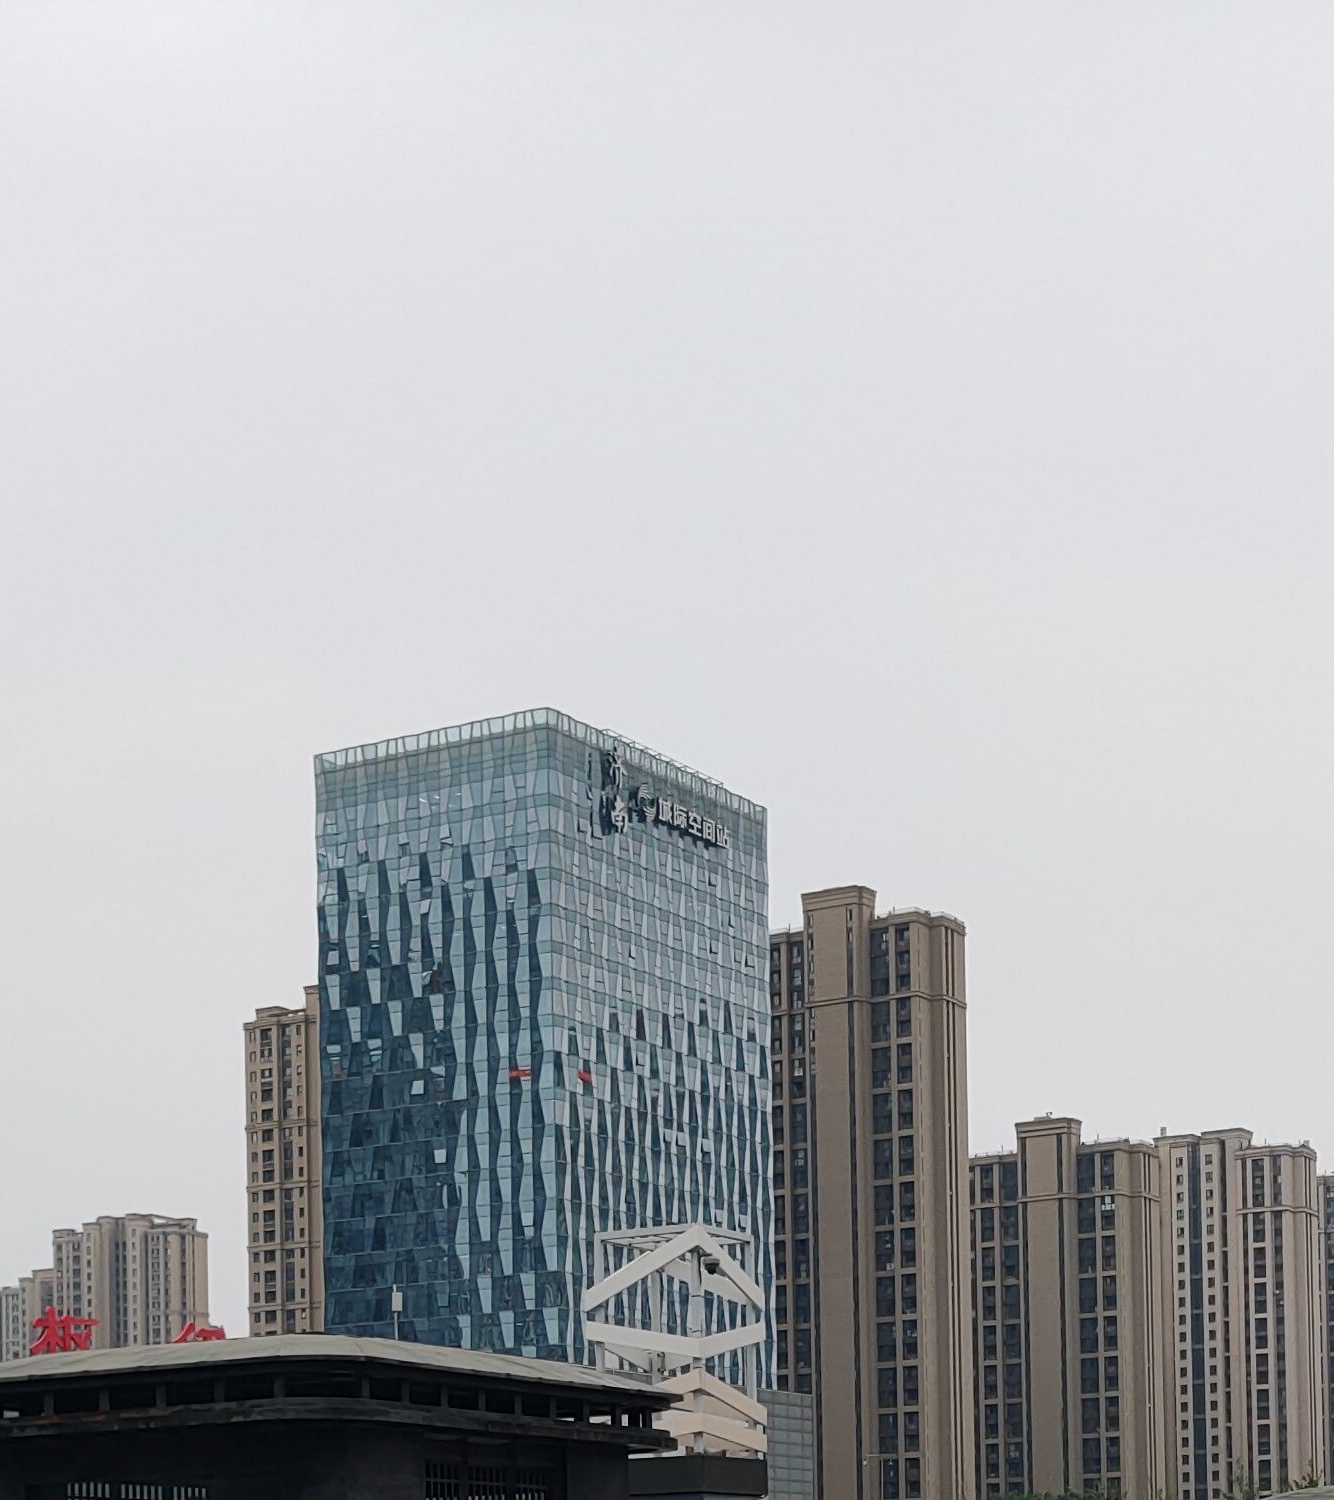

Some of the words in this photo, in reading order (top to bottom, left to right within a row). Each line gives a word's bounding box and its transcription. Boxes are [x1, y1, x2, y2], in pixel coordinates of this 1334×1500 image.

[658, 797, 731, 849] 城际空间站
